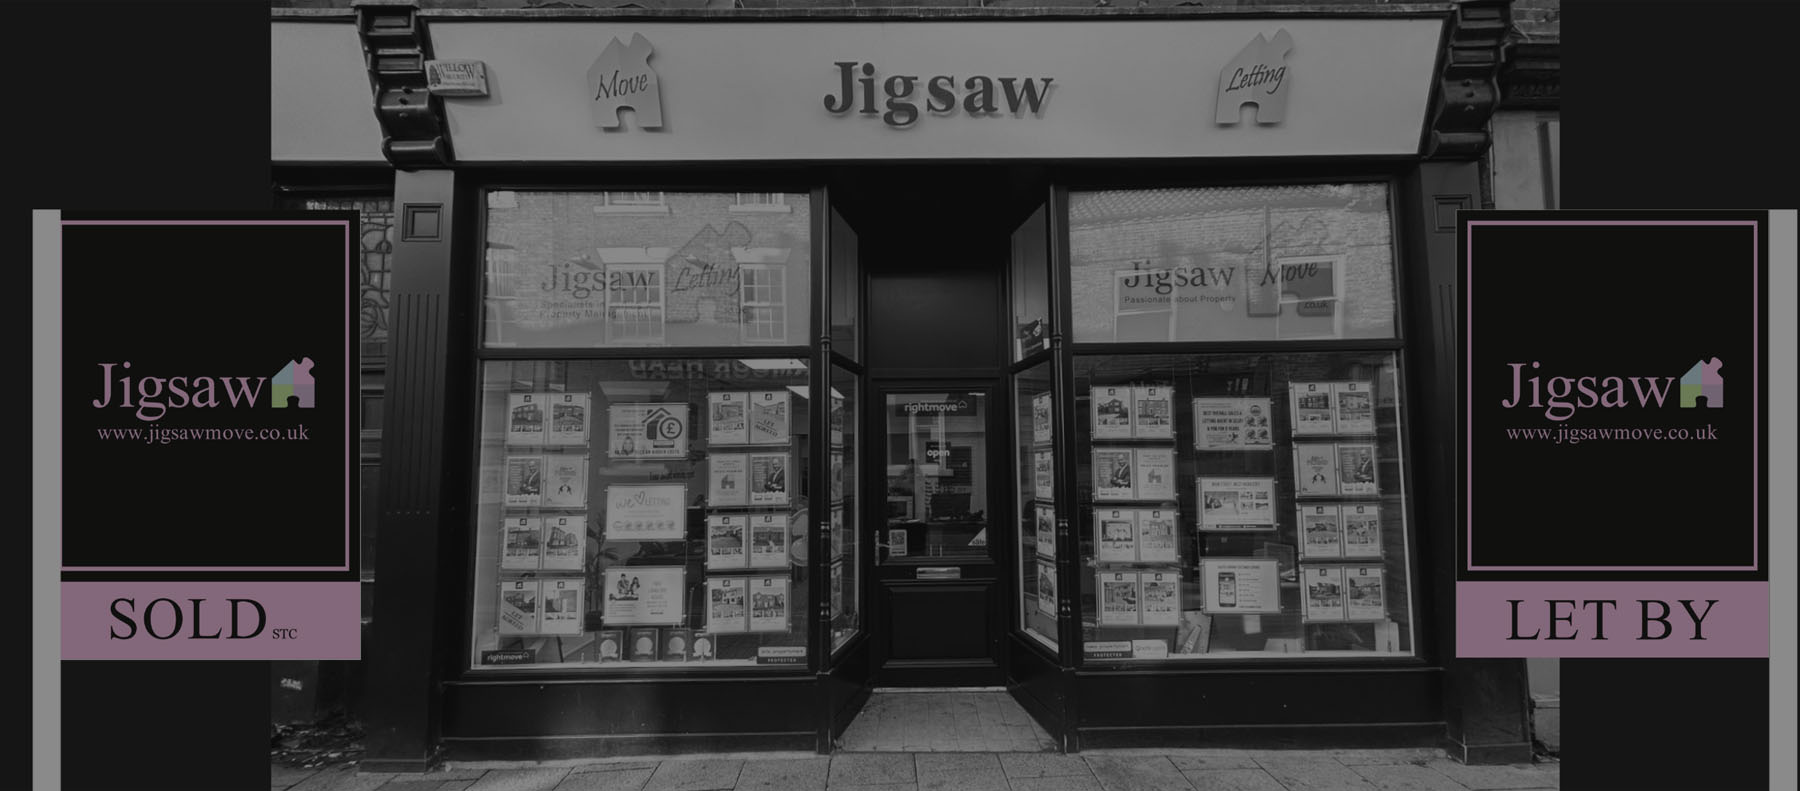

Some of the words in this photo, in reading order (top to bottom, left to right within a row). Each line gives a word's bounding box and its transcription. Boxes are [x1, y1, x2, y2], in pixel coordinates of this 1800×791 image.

[595, 70, 648, 101] Move
[824, 61, 1054, 126] Jigsaw
[1225, 64, 1286, 95] Letting
[541, 263, 655, 299] Jigsaw
[672, 263, 741, 297] Letting
[1124, 260, 1235, 294] Jigsaw
[1259, 262, 1319, 287] Move
[1124, 295, 1171, 304] Passionate
[1174, 295, 1198, 303] about
[1200, 295, 1236, 304] Property
[92, 361, 267, 421] Jigsaw
[1501, 361, 1676, 421] Jigsaw
[904, 401, 958, 414] rightmove
[97, 424, 310, 445] www.jigsawmove.co.uk
[1506, 424, 1718, 445] www.jigsawmove.co.uk
[927, 449, 950, 458] open
[110, 597, 267, 640] SOLD
[272, 628, 298, 640] STC
[1506, 599, 1617, 641] LET
[1636, 599, 1719, 641] BY
[487, 653, 524, 663] rightmove
